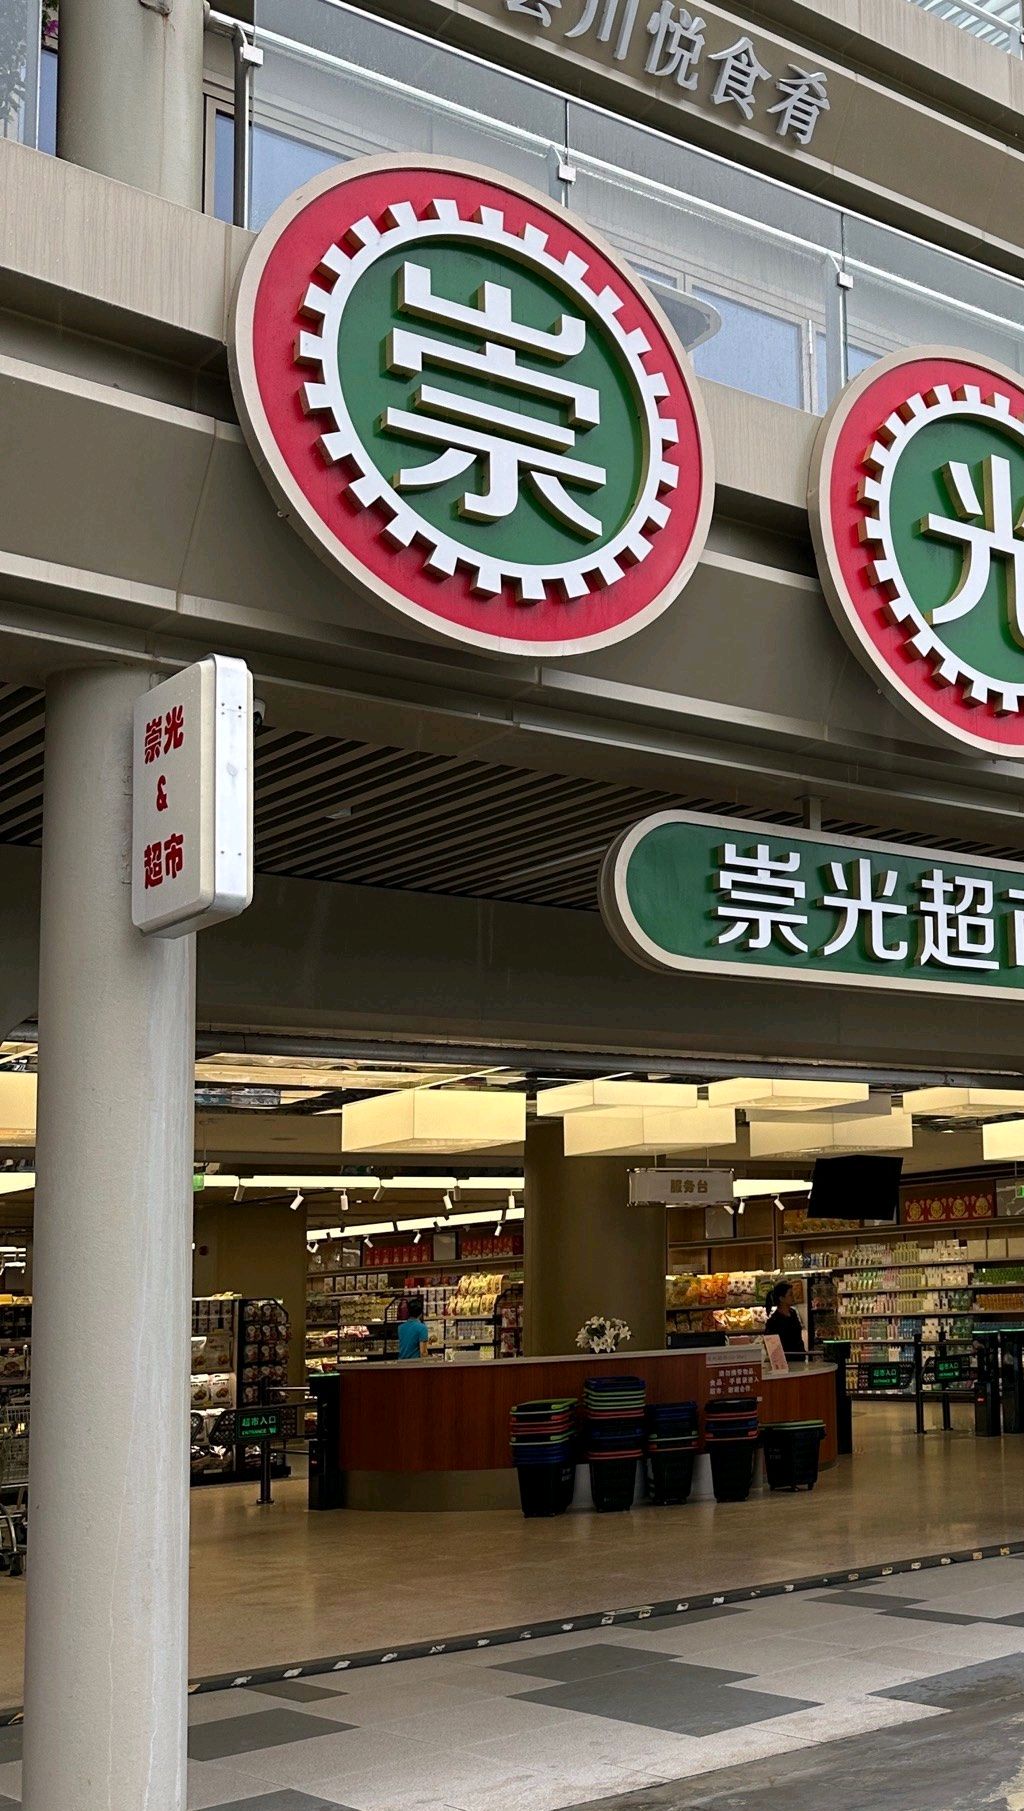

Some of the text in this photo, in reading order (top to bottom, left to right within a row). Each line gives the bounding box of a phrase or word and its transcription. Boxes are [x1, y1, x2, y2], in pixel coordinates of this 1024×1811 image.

[380, 261, 607, 537] 崇
[144, 705, 184, 764] 崇光
[156, 775, 168, 811] &
[144, 833, 184, 889] 超市
[671, 1180, 708, 1193] 服务台
[242, 1416, 276, 1426] 超市入口
